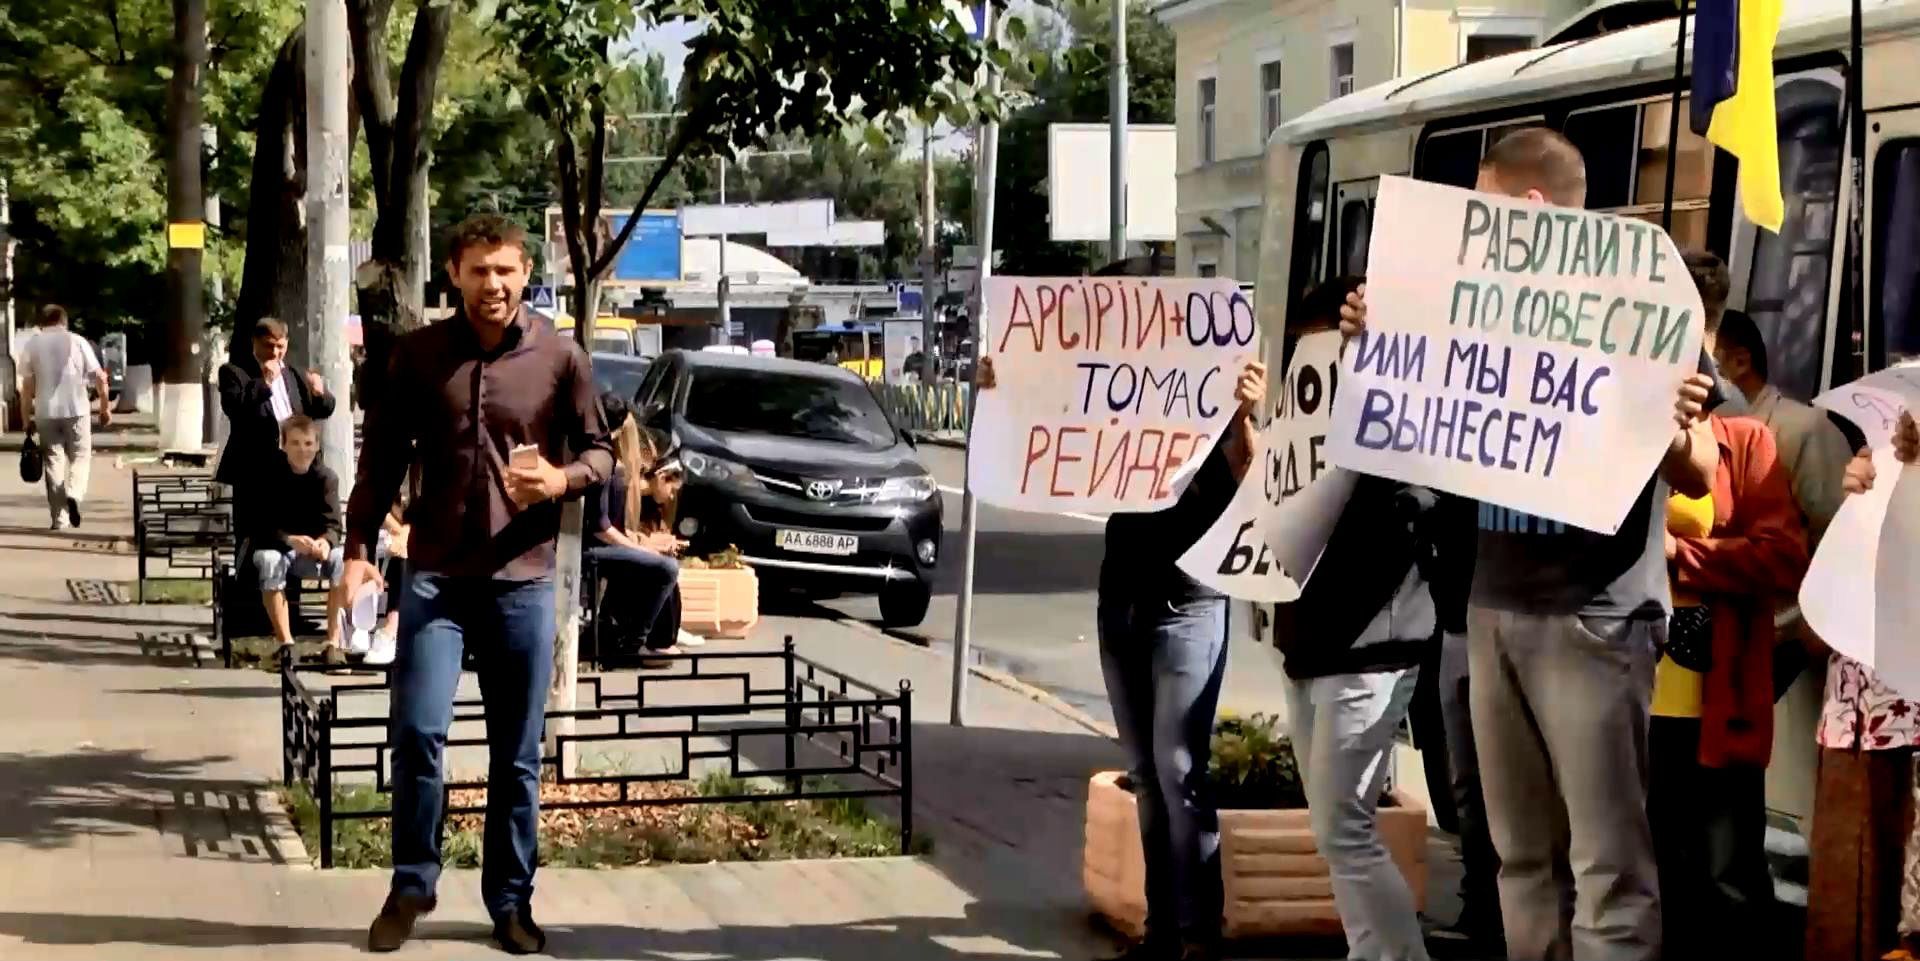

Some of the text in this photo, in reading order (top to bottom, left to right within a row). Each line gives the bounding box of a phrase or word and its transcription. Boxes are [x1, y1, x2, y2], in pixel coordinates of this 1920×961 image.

[1457, 199, 1667, 283] РАБОТАЙТЕ
[1449, 280, 1693, 365] ПО СОВЕСТИ
[1077, 363, 1221, 418] ТОМАС
[1353, 329, 1611, 416] ИЛИ МЫ ВАС
[1355, 388, 1562, 477] ВЫНЕСЕМ
